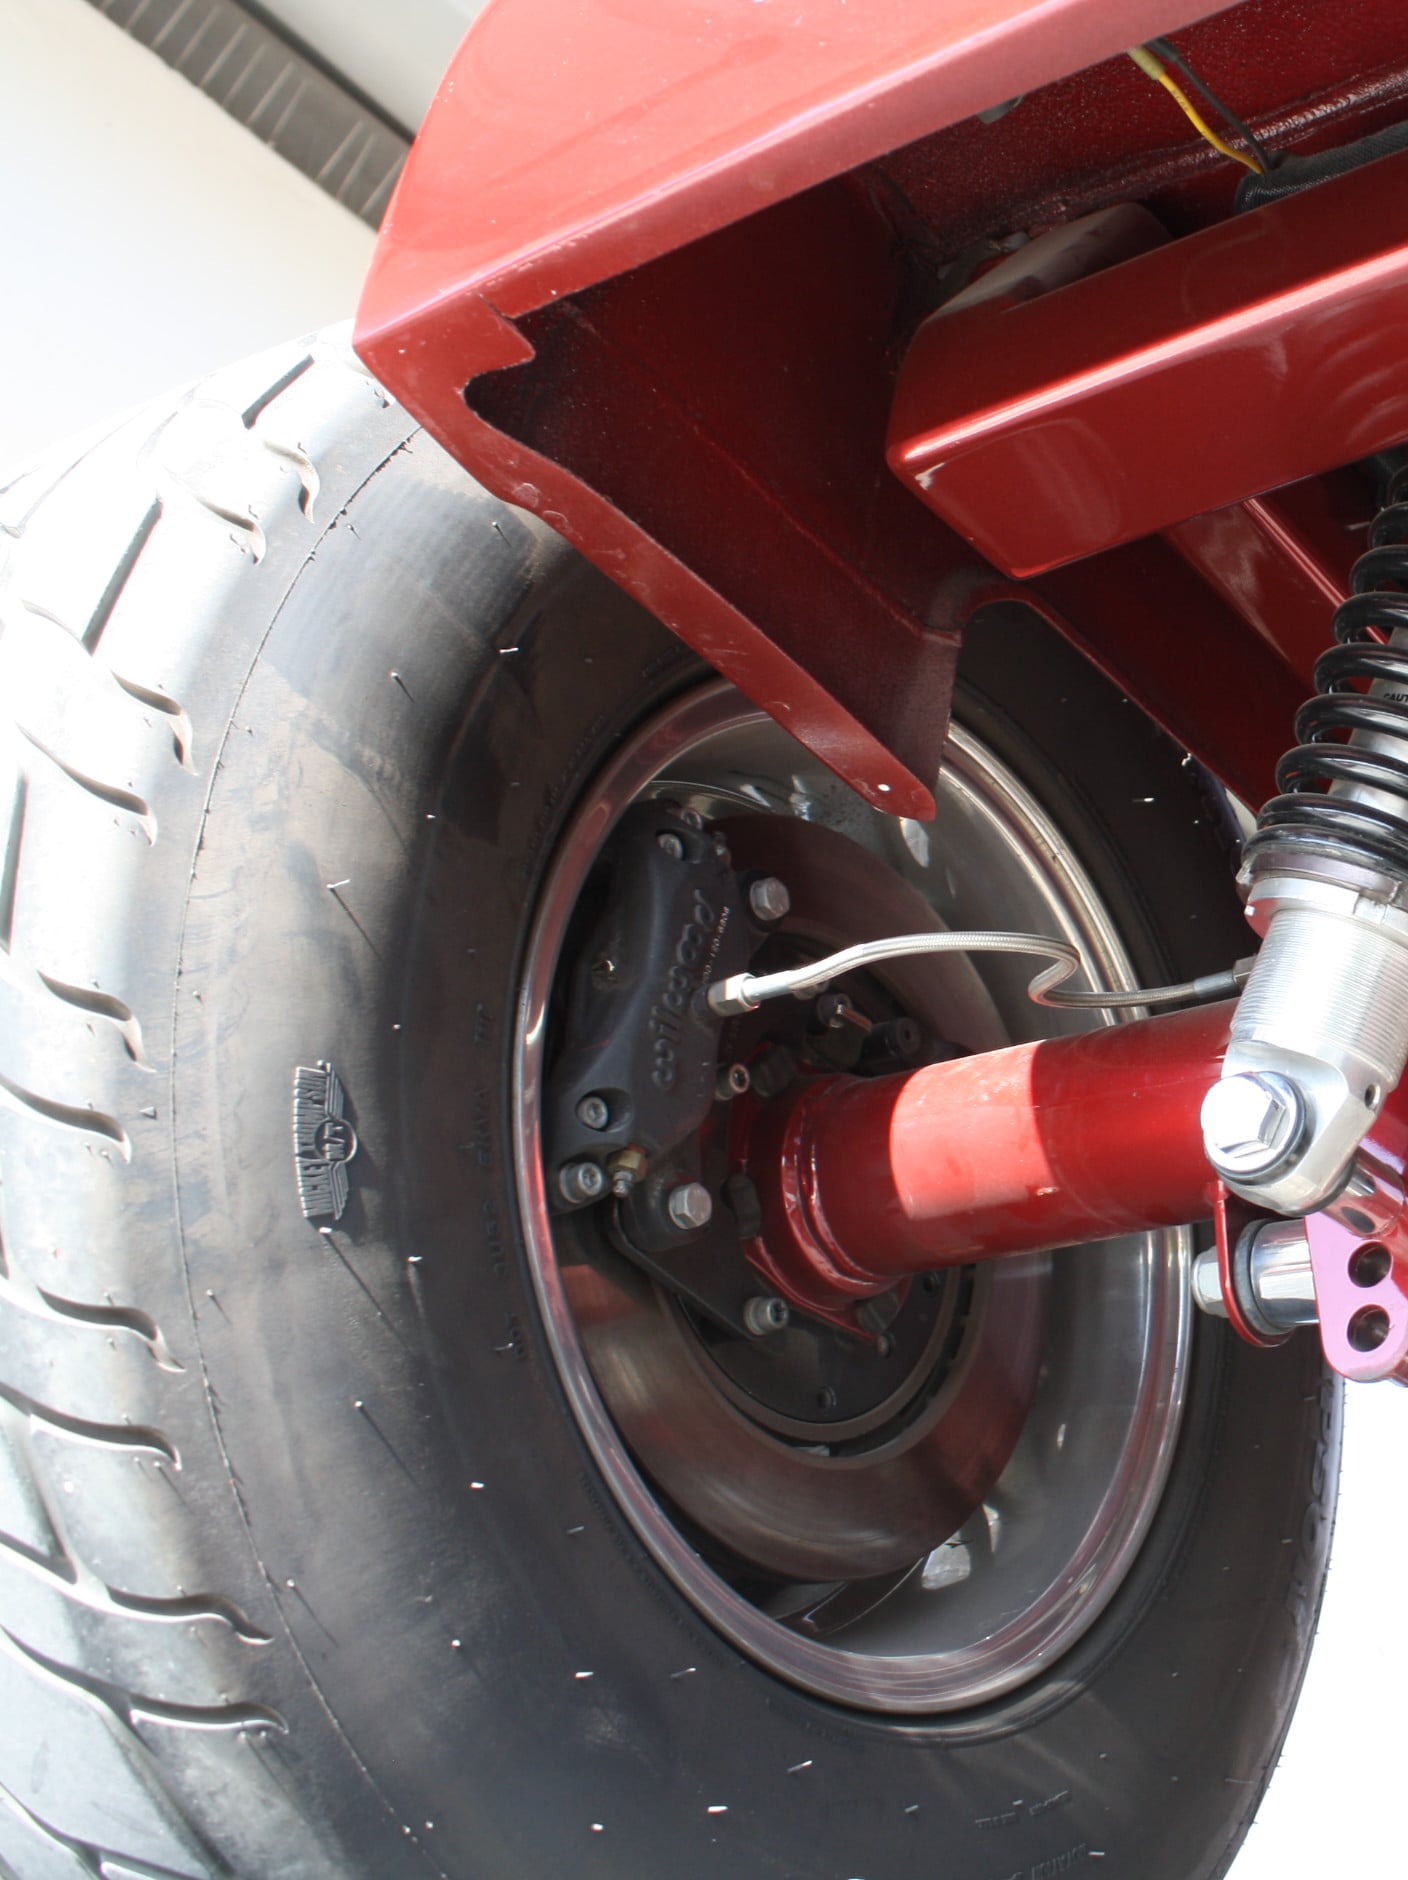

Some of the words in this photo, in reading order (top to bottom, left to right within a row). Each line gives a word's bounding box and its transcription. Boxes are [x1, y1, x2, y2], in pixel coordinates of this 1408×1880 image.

[649, 888, 715, 1090] wilwood
[292, 1067, 328, 1154] THOMPSON
[323, 1121, 346, 1160] M/T
[295, 1157, 334, 1217] MICKEY
